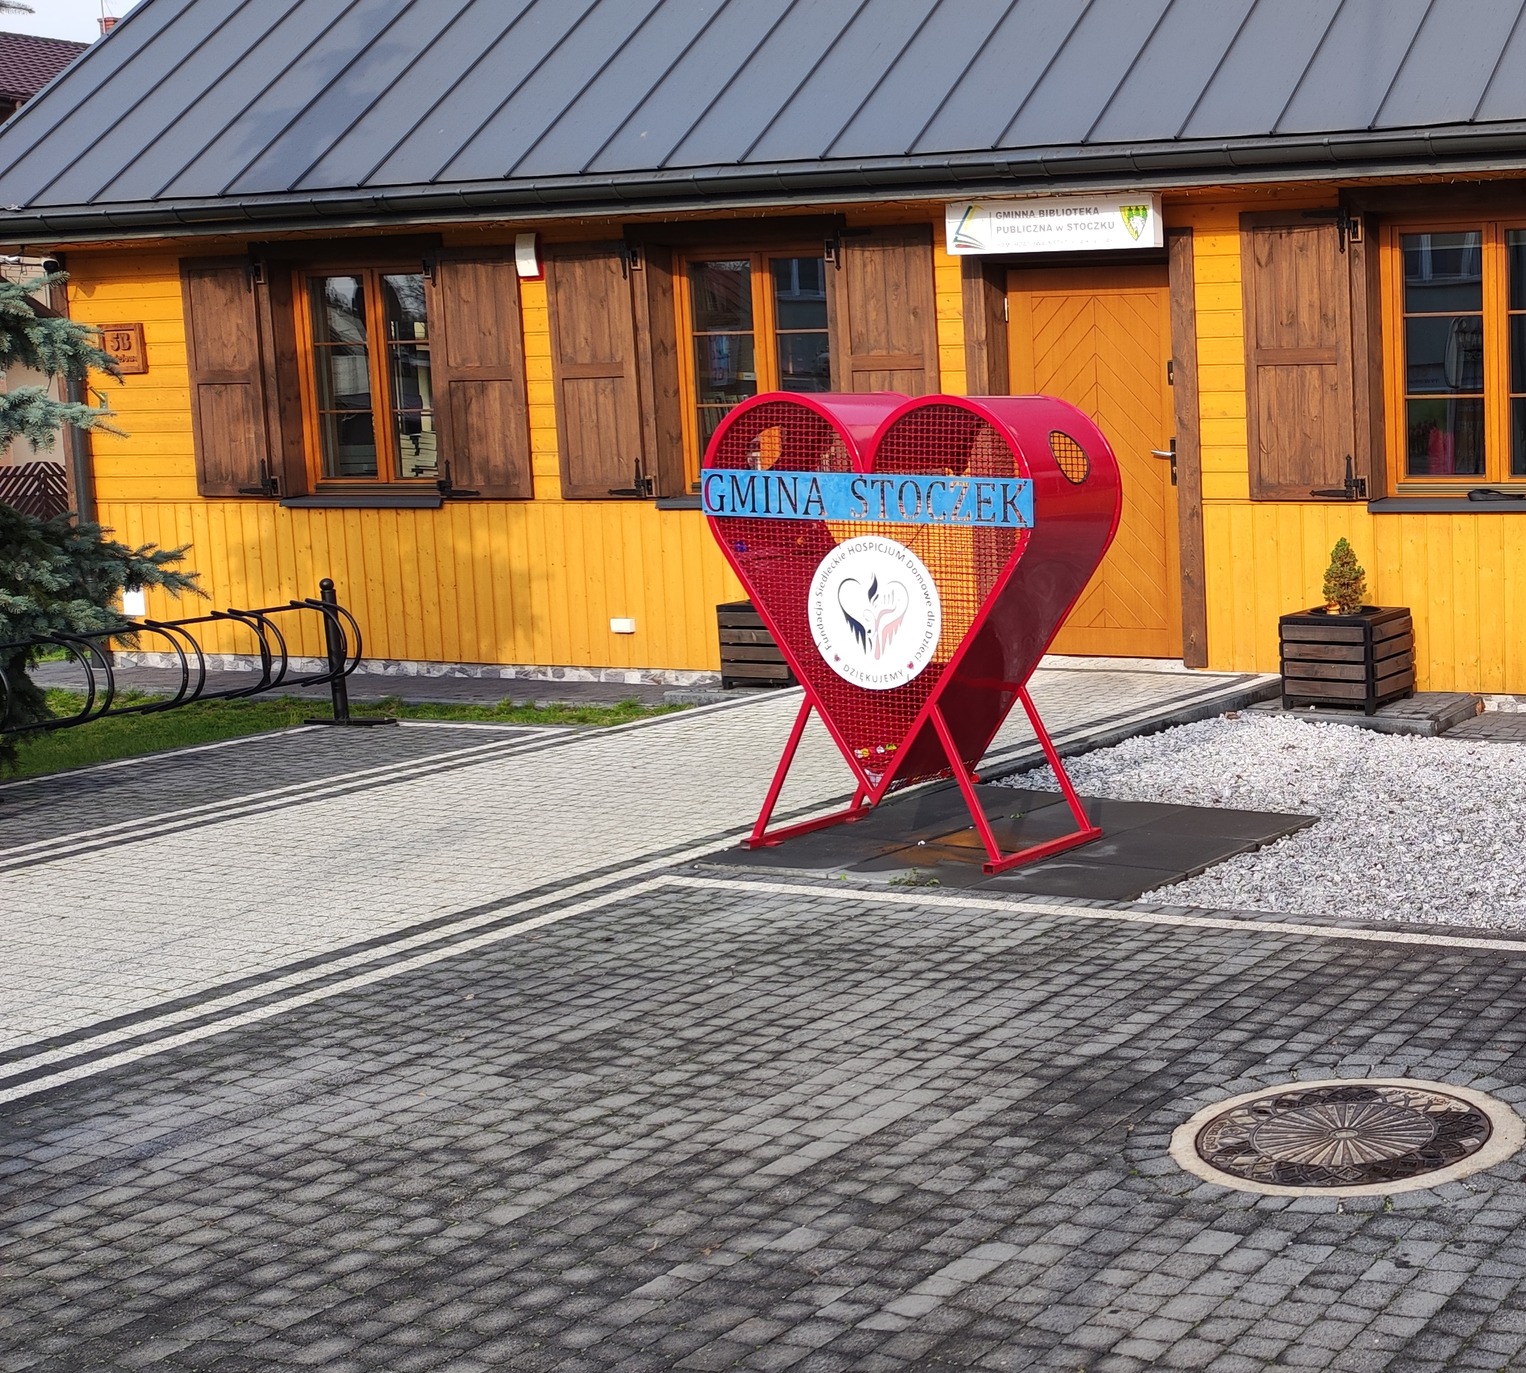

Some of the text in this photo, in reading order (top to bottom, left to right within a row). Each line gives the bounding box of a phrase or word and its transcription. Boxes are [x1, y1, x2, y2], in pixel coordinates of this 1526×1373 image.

[995, 207, 1100, 220] GMINNA BIBLIOTEKA
[996, 224, 1053, 234] PUBLICZNA
[1066, 221, 1115, 231] STOCZKU
[704, 473, 1030, 525] GMINA STOCZEK
[814, 542, 936, 662] Fundacja Siedleckie HOSPICJUM Domowe dla Dzieci
[843, 664, 904, 684] DZIĘKUJEMY
